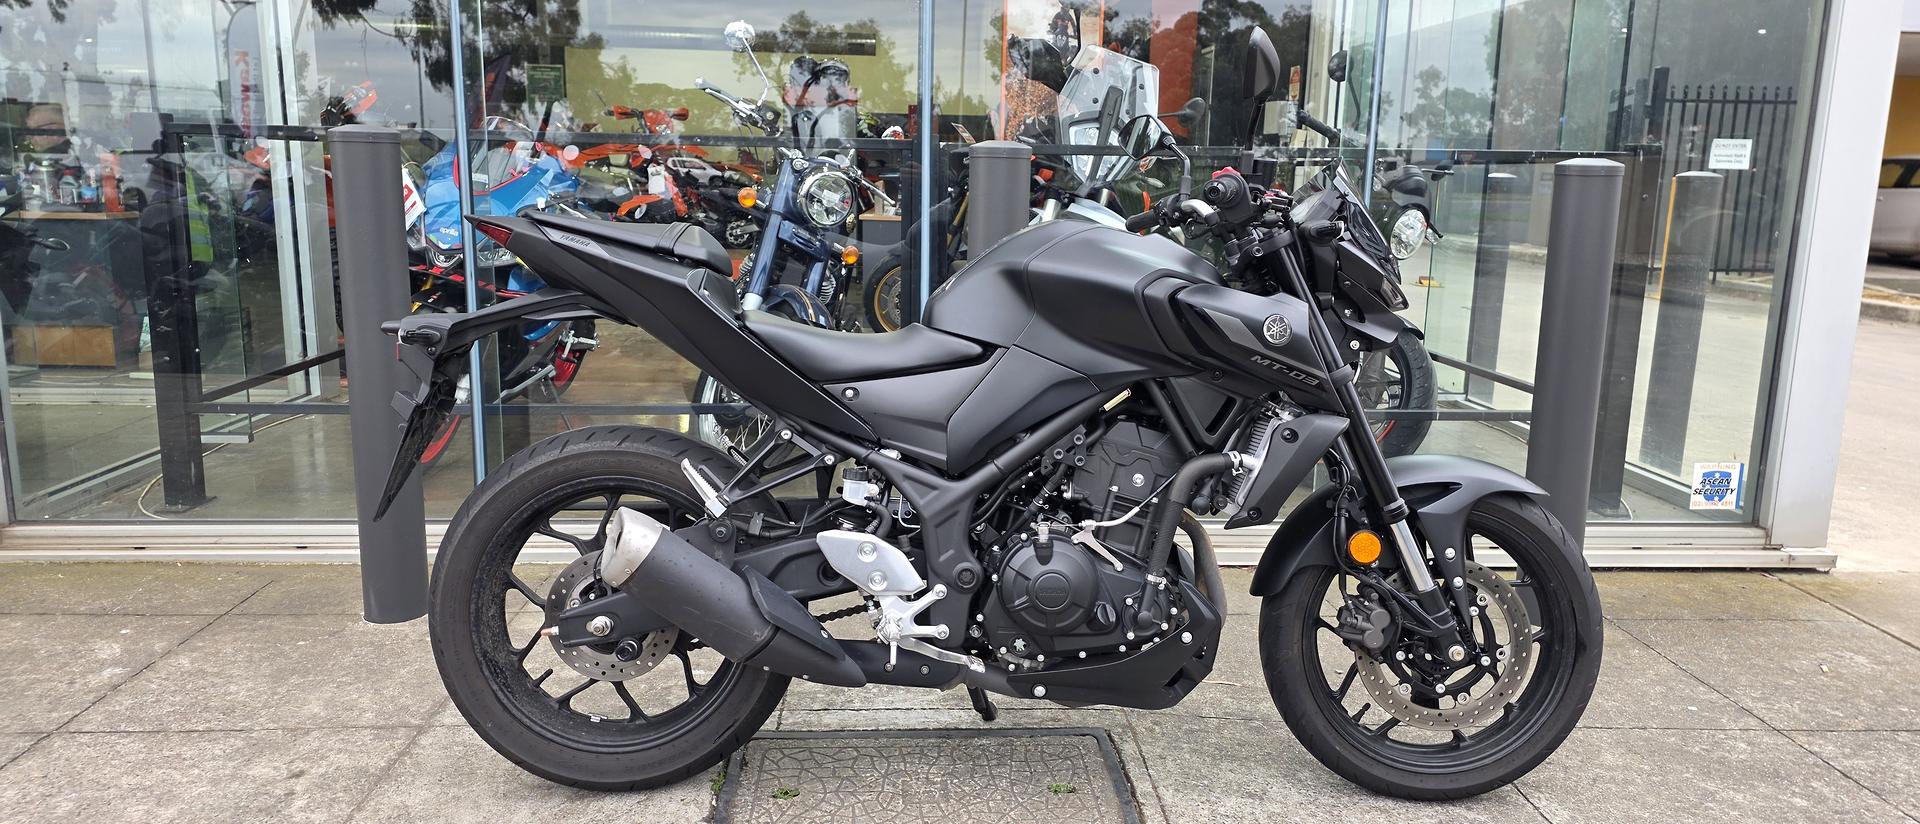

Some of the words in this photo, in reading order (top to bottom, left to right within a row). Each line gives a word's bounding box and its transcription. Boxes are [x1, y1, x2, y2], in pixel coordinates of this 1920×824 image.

[439, 226, 459, 237] aprilia
[560, 234, 591, 248] YAMAHA
[1250, 355, 1320, 385] MT-03
